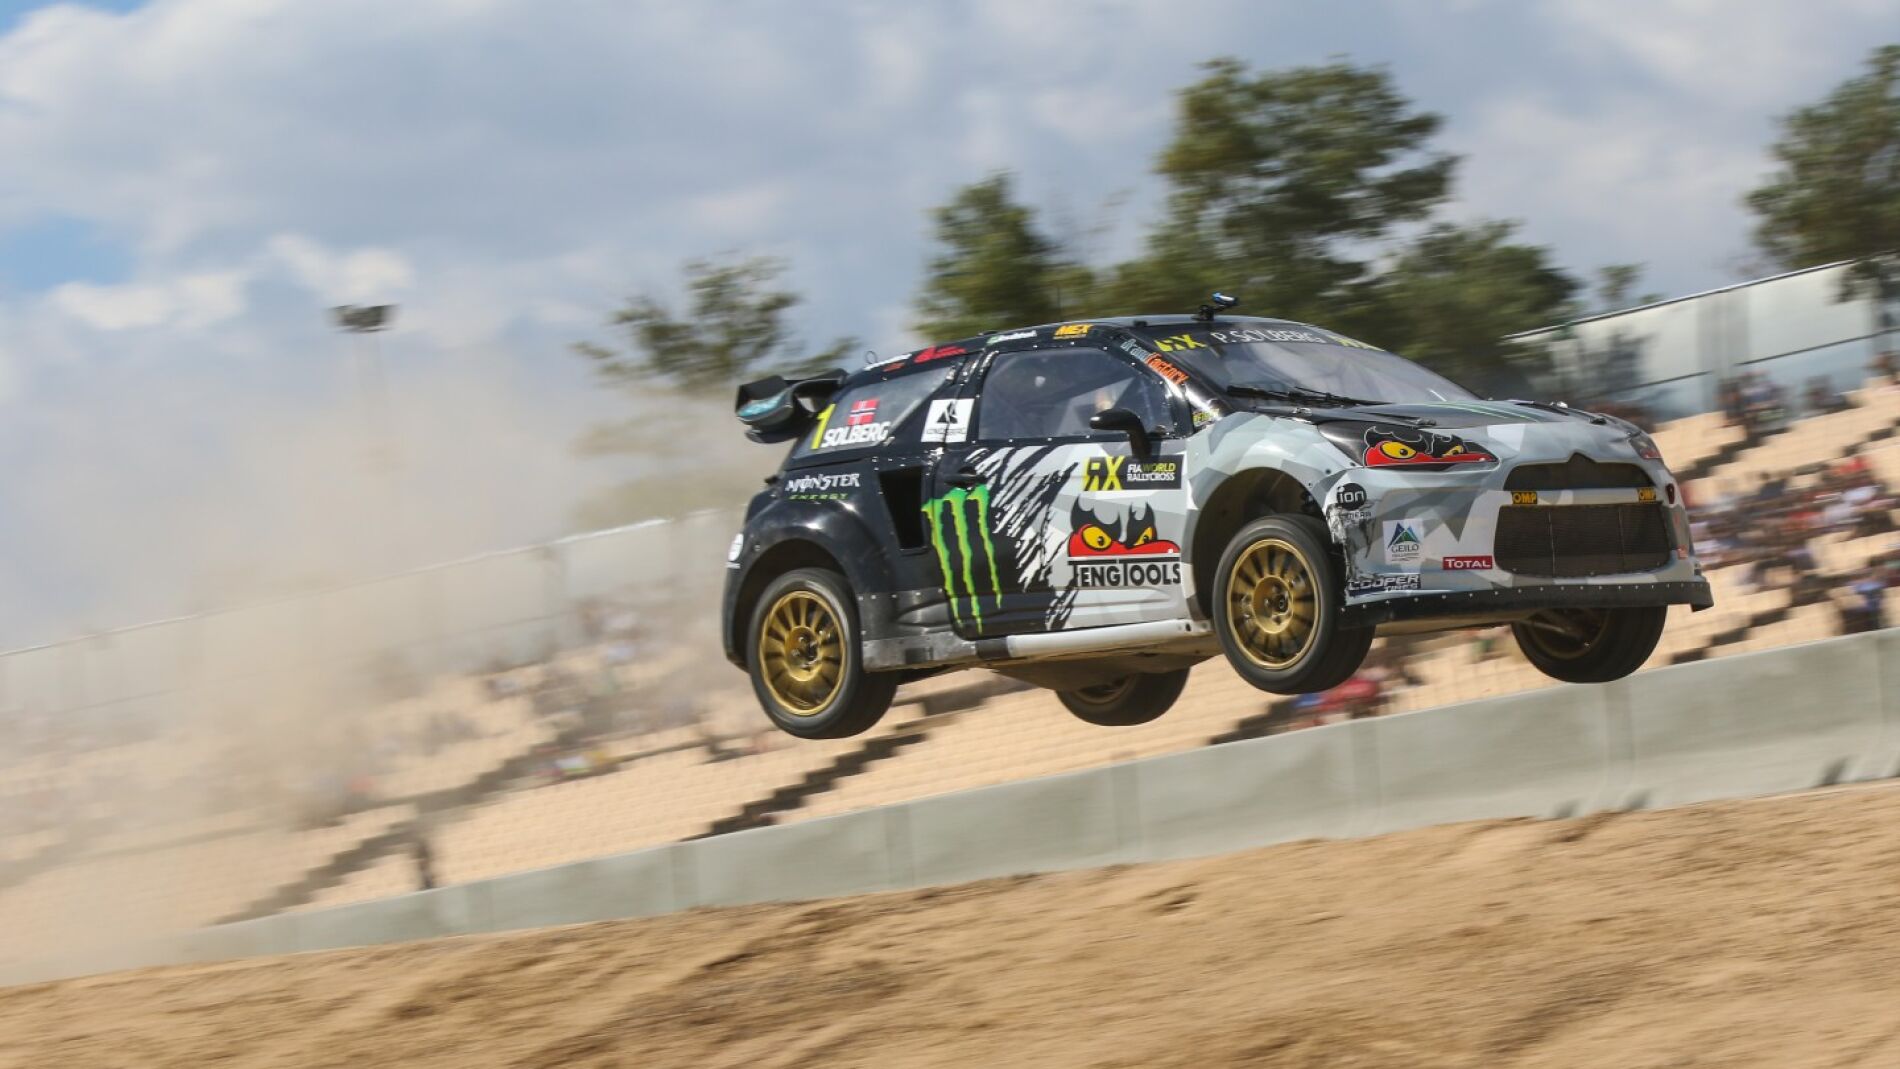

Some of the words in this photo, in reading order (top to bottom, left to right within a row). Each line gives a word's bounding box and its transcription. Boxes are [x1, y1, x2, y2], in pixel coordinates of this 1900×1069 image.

[811, 403, 836, 450] 1
[821, 421, 891, 448] SOLBERG
[1083, 455, 1126, 491] RX
[1127, 472, 1175, 482] RALLYCROSS
[784, 473, 860, 493] MONSTER
[1338, 486, 1365, 502] ion
[1513, 492, 1537, 504] OMP
[1638, 489, 1657, 502] OMP
[1391, 543, 1420, 554] GEILO
[1445, 558, 1492, 570] TOTAL
[1347, 573, 1420, 592] COOPER
